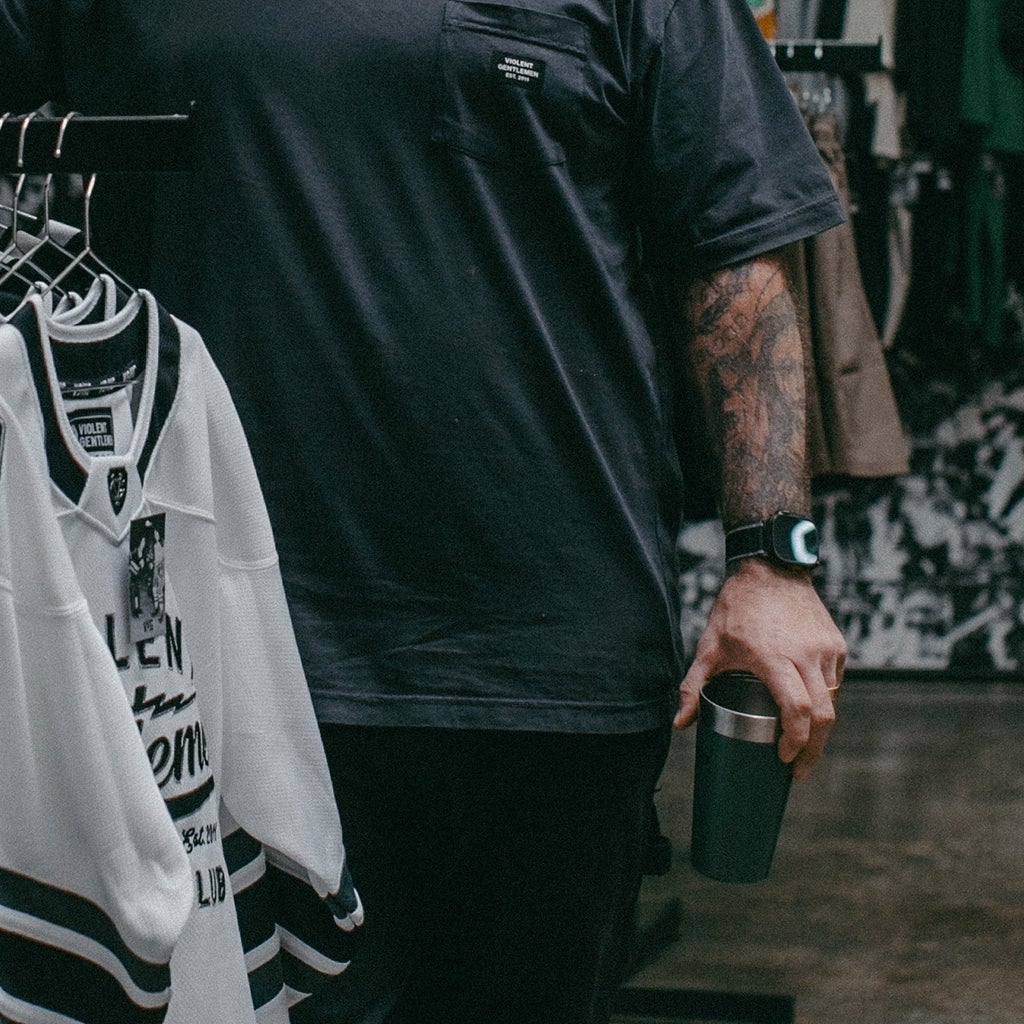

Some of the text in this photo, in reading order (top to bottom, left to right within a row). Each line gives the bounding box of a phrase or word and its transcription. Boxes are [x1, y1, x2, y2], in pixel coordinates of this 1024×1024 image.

[497, 63, 539, 78] GENTLEMEN
[504, 57, 534, 69] VIOLENT
[105, 612, 194, 680] LEN
